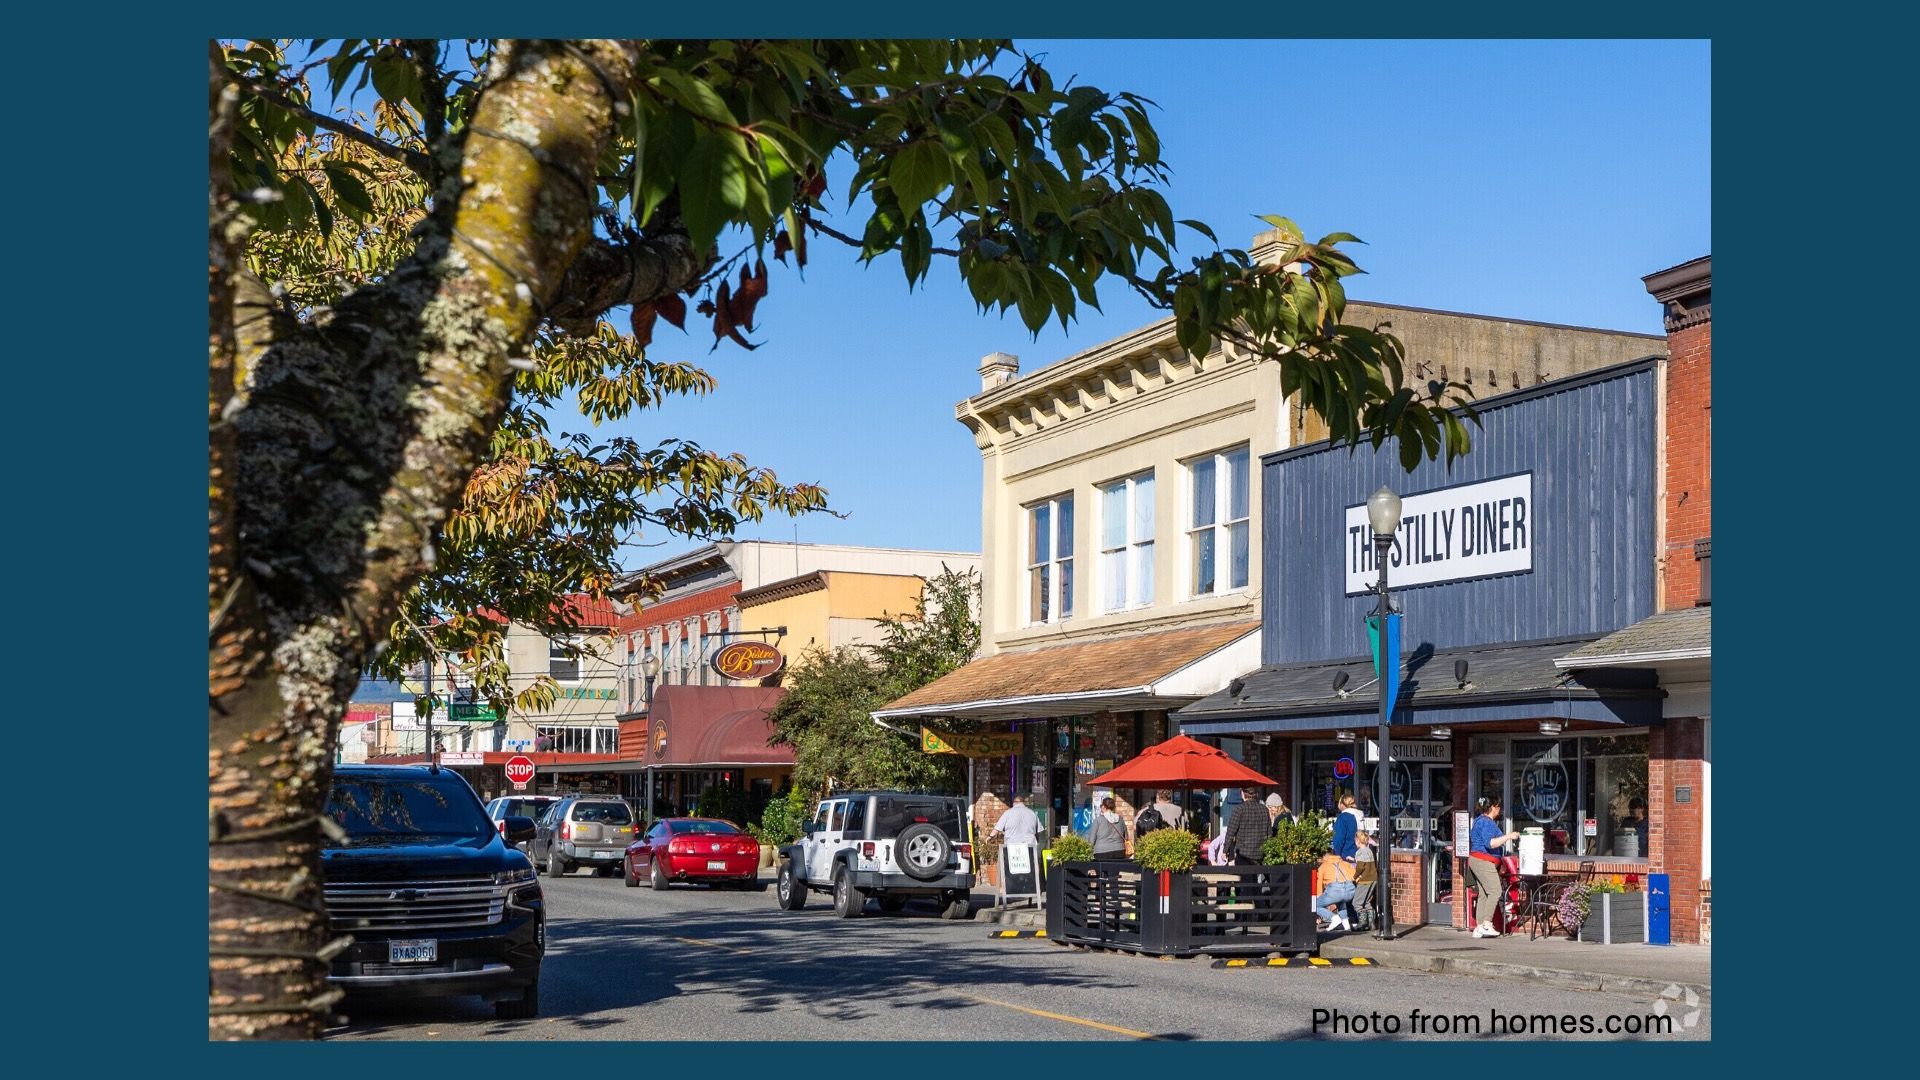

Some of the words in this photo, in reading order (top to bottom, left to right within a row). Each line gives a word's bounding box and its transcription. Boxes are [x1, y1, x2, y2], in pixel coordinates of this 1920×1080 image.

[1390, 508, 1455, 569] STILLY
[1461, 496, 1526, 558] DINER
[722, 645, 774, 672] Bistro
[979, 736, 1018, 753] STOP
[1393, 743, 1419, 757] STILLY
[1422, 744, 1444, 757] DINER
[507, 764, 532, 776] STOP
[1336, 761, 1354, 774] OPEN
[1529, 793, 1560, 812] DINER
[393, 946, 434, 958] BXA9060
